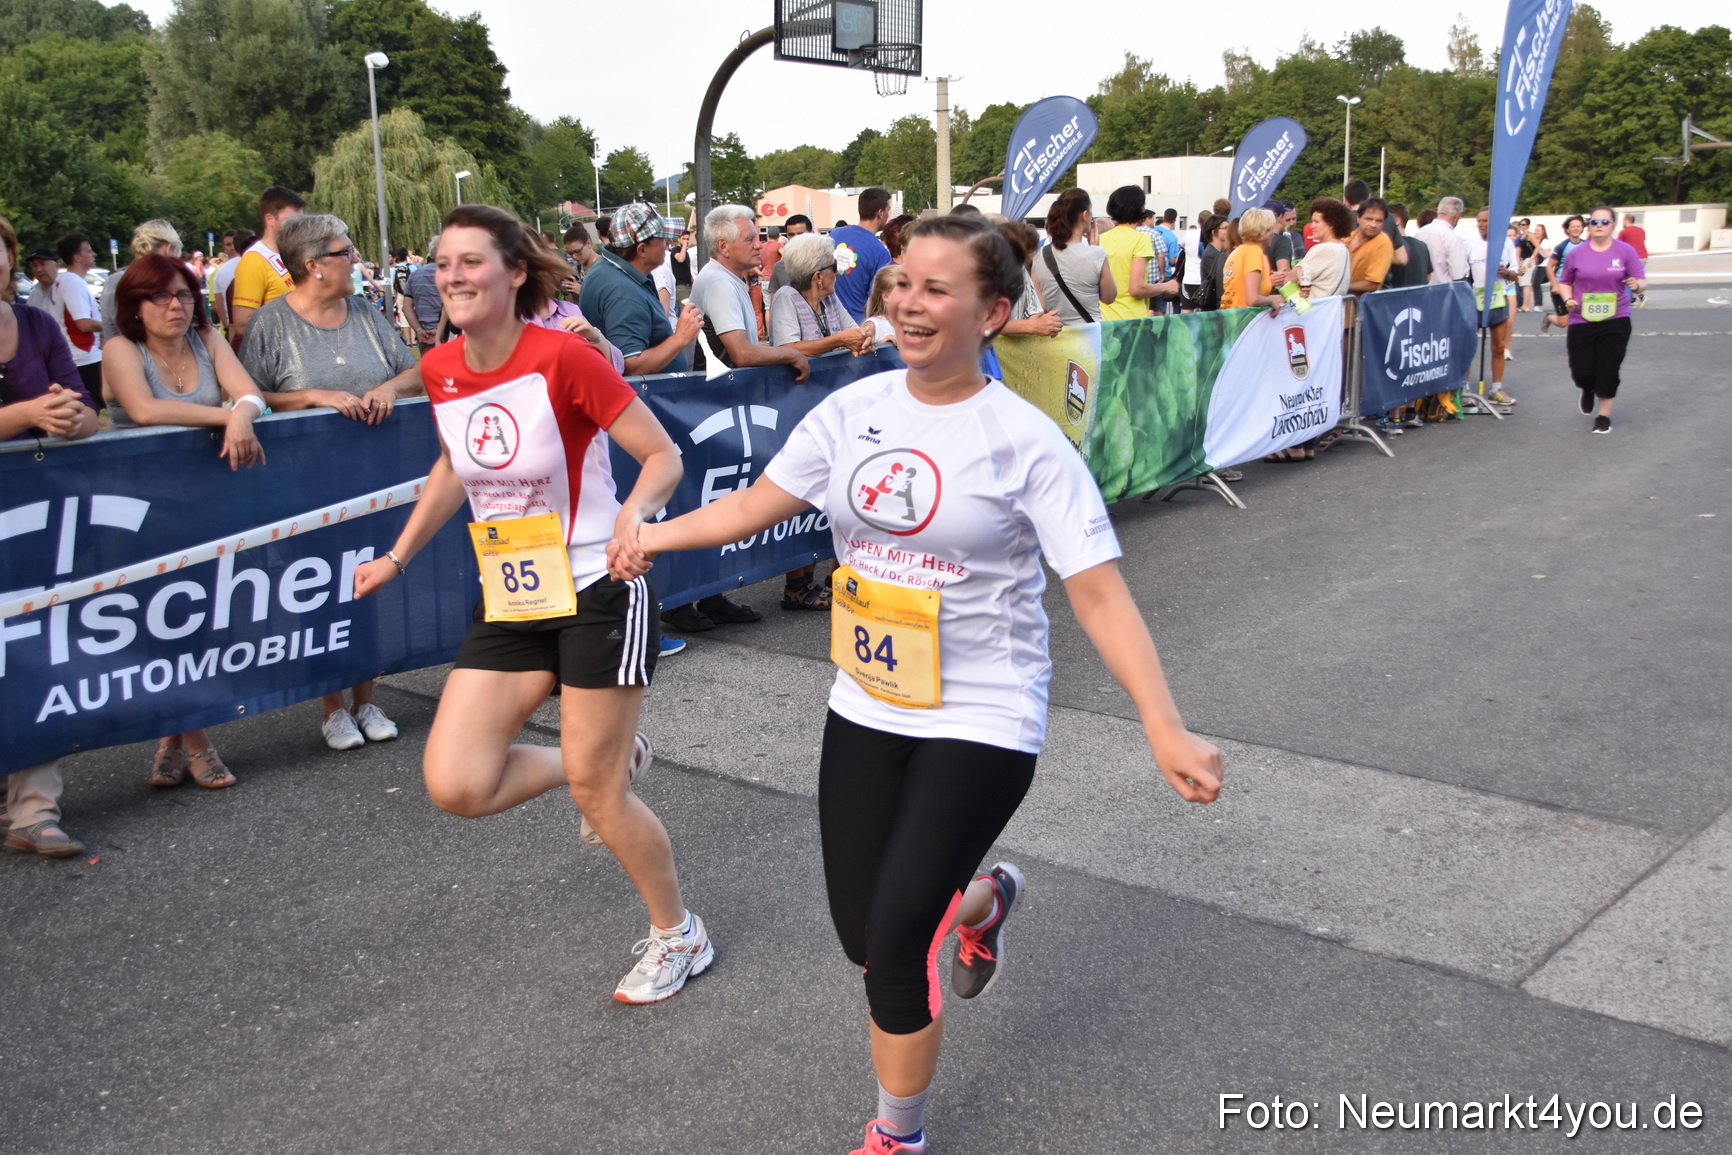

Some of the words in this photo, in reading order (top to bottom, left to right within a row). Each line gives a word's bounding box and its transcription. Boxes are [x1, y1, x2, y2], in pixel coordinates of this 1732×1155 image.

[1023, 114, 1078, 183] Fischer
[1038, 130, 1083, 183] AUTOMOBILE
[1246, 130, 1290, 192] Fischer
[1260, 141, 1294, 192] AUTOMOBILE
[760, 202, 788, 217] G6
[1588, 304, 1609, 314] 688
[1401, 363, 1449, 387] AUTOMOBILE
[857, 434, 881, 445] erima
[497, 479, 516, 488] MIT
[520, 476, 552, 488] HERZ
[501, 559, 540, 594] 85
[887, 549, 916, 566] MIT
[922, 553, 966, 577] HERZ
[889, 570, 904, 583] Dr.
[854, 624, 898, 672] 84
[36, 619, 352, 723] AUTOMOBILE
